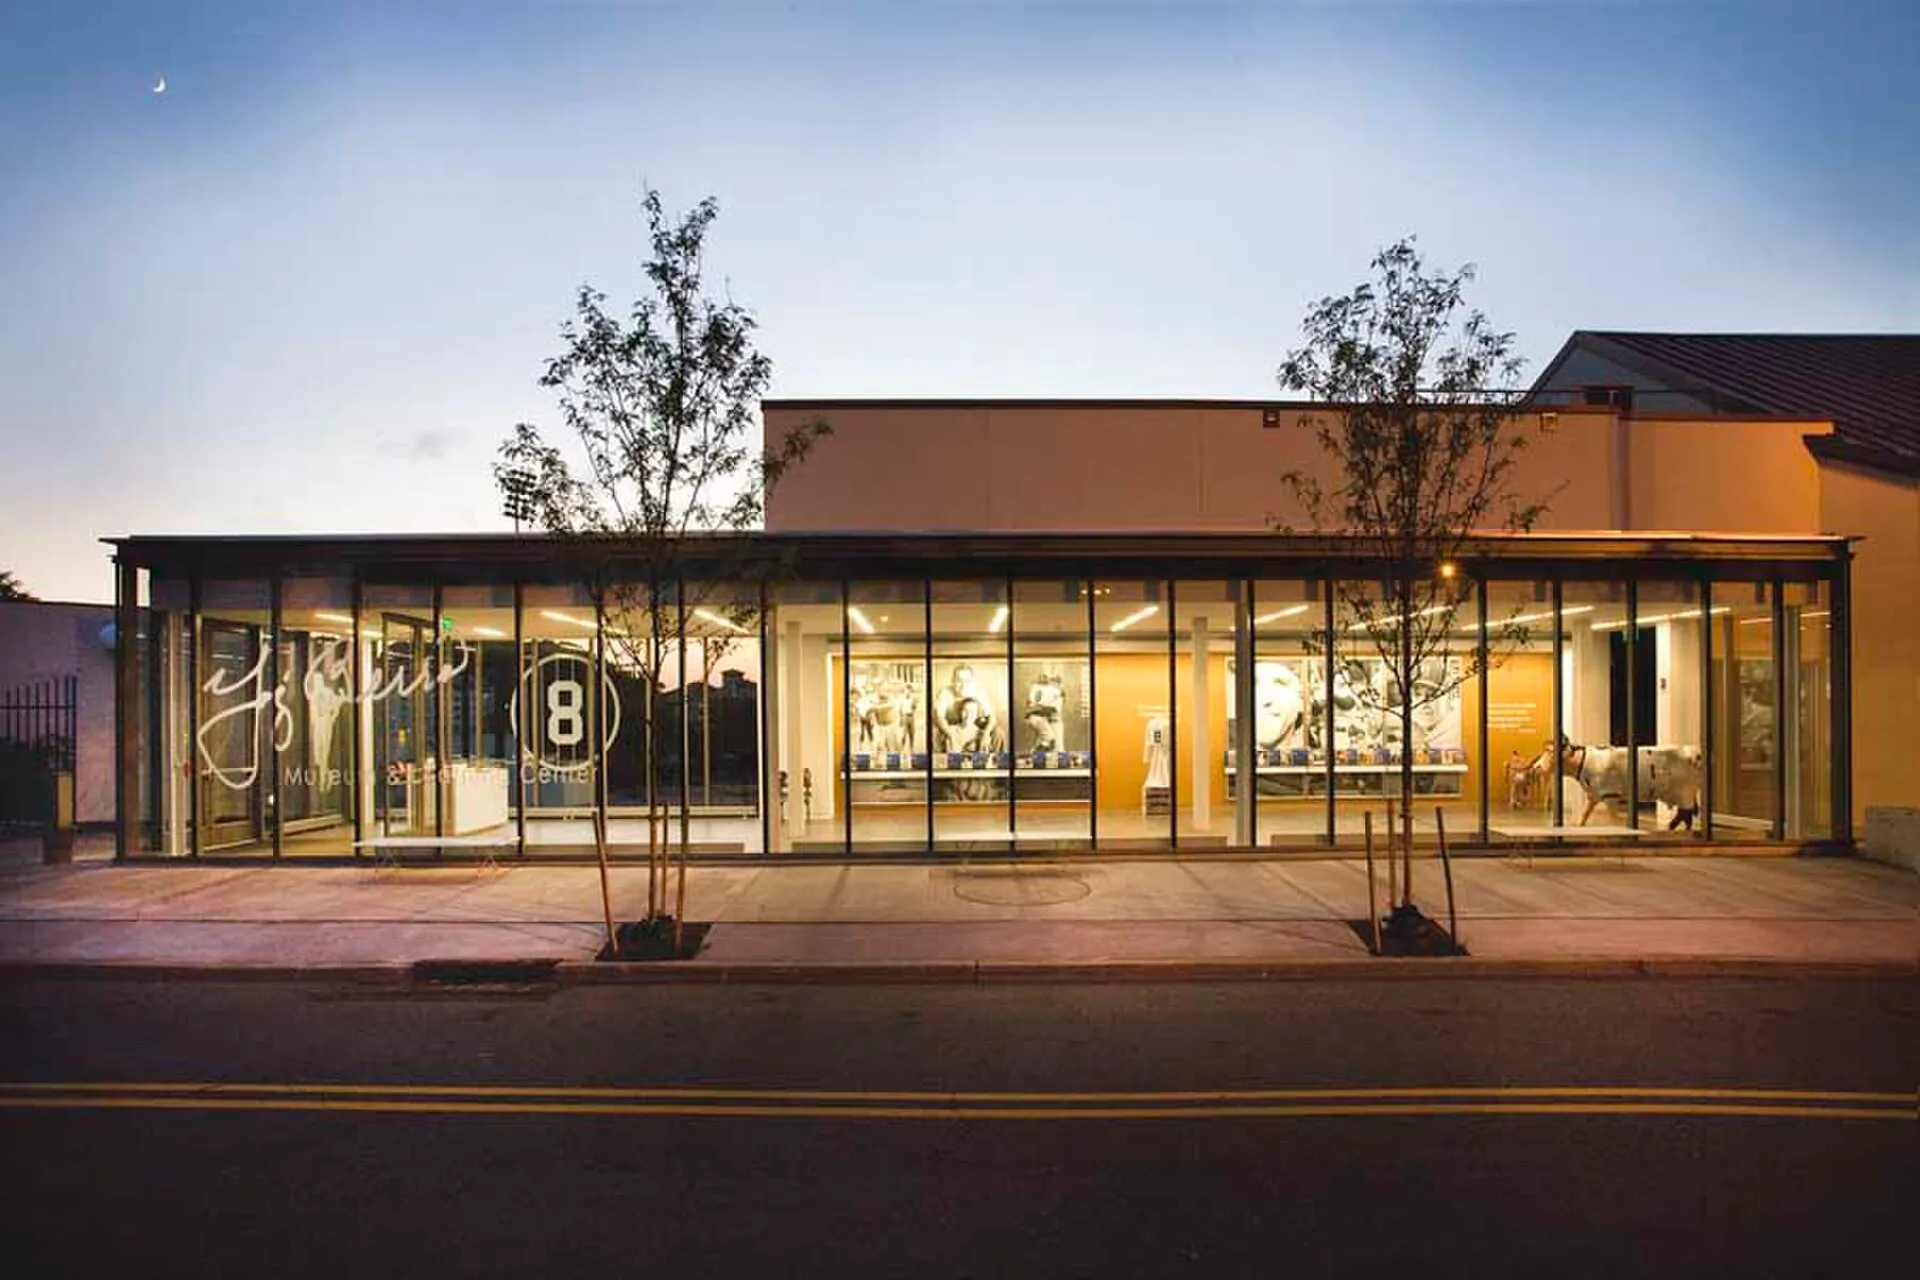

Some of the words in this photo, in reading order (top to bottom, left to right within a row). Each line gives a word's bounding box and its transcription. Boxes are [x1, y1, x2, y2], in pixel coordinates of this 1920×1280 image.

[547, 680, 583, 746] 8
[284, 765, 374, 786] Mueu
[521, 763, 598, 785] Center
